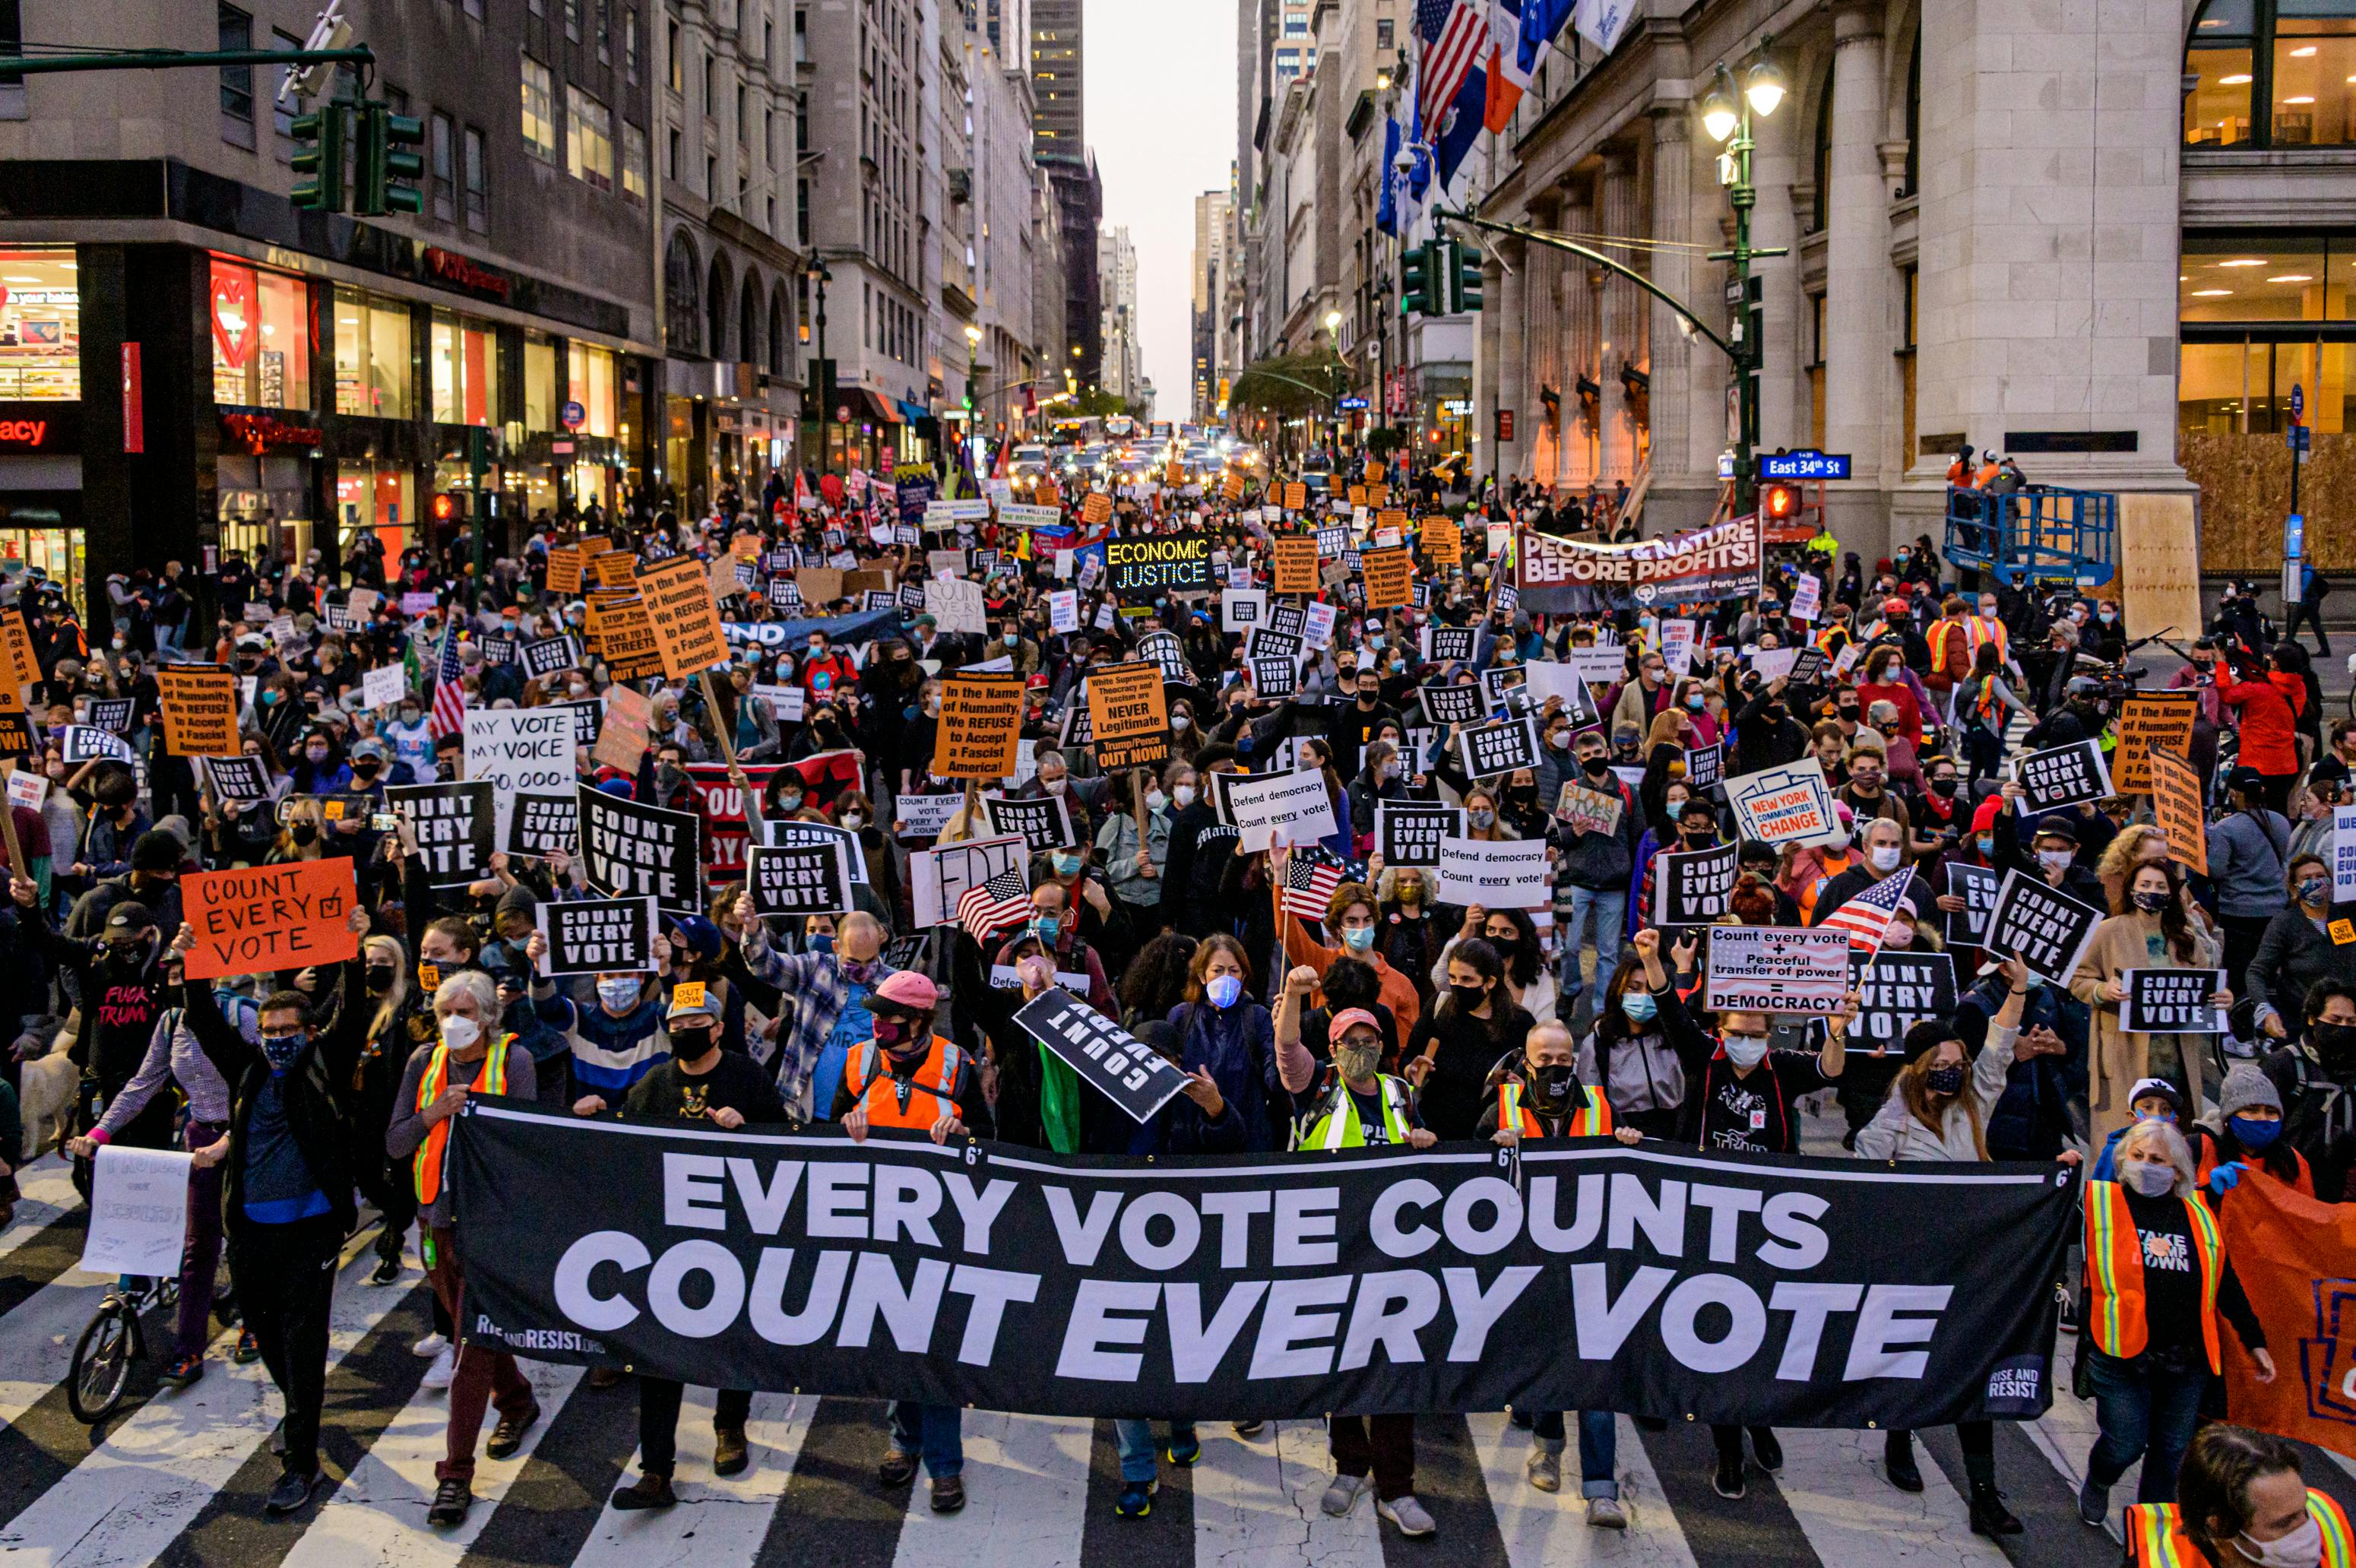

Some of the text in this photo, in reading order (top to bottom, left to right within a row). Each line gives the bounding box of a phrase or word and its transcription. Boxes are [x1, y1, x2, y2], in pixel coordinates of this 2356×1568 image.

[1770, 460, 1840, 474] East 34th St
[1015, 515, 1058, 524] REVOLUTION
[1524, 519, 1755, 561] PEOPLE & NATURE
[1108, 539, 1208, 565] ECONOMIC
[1525, 540, 1756, 583] BEFORE PROFITS!
[1116, 561, 1206, 589] JUSTICE
[1658, 575, 1758, 594] Communist Party USA
[604, 629, 643, 642] TAKE TO
[665, 616, 711, 639] to Accept
[607, 637, 657, 655] STREETS
[672, 631, 714, 654] a Fascist
[1258, 641, 1294, 655] EVERY
[1260, 633, 1296, 646] COUNT
[1436, 639, 1468, 648] EVERY
[677, 647, 719, 670] America!
[1436, 648, 1466, 657] VOTE
[1260, 661, 1289, 670] COUNT
[1116, 673, 1157, 684] Supremacy,
[1261, 670, 1290, 680] EVERY
[946, 686, 1019, 698] In the Name
[1099, 685, 1137, 695] Theocracy
[1262, 680, 1290, 693] VOTE
[1432, 689, 1472, 699] COUNT
[1104, 694, 1136, 703] Fascism
[1433, 698, 1474, 709] EVERY
[943, 702, 1019, 715] of Humanity,
[1108, 702, 1149, 720] NEVER
[1436, 707, 1477, 721] VOTE
[2126, 705, 2191, 717] In the Name
[471, 716, 567, 736] MY VOTE
[946, 716, 1014, 728] We REFUSE
[1100, 716, 1161, 733] Legitimate
[2123, 721, 2190, 733] of Humanity,
[950, 731, 1006, 745] to Accept
[1104, 736, 1161, 752] Trump/Pence
[1475, 727, 1519, 744] COUNT
[2124, 735, 2184, 746] We REFUSE
[179, 741, 227, 752] America!
[471, 739, 565, 760] MY VOICE
[949, 747, 1004, 758] a Fascist
[1477, 736, 1522, 755] EVERY
[1098, 744, 1167, 768] OUT NOW!
[1480, 749, 1525, 768] VOTE
[2024, 750, 2082, 776] COUNT
[948, 761, 1002, 772] America!
[2027, 762, 2085, 789] EVERY
[935, 796, 961, 804] EVERY
[1233, 781, 1323, 808] Defend democracy
[1564, 784, 1615, 814] BLACK
[1752, 790, 1810, 814] NEW YORK
[996, 806, 1047, 818] COUNT
[1239, 801, 1330, 829] Count every vote!
[1757, 804, 1810, 822] COMMUNITIES
[592, 803, 676, 842] COUNT
[999, 817, 1048, 831] EVERY
[1394, 816, 1450, 828] COUNT
[1759, 812, 1820, 838] CHANGE
[1394, 828, 1449, 844] EVERY
[592, 828, 675, 868] EVERY
[1441, 848, 1544, 864] Defend democracy
[759, 854, 822, 870] COUNT
[1683, 854, 1734, 876] COUNT
[593, 856, 676, 898] VOTE
[759, 869, 824, 887] EVERY
[1441, 868, 1544, 885] Count every vote!
[202, 870, 303, 906] COUNT
[761, 886, 830, 907] VOTE
[207, 894, 311, 936] EVERY
[562, 908, 633, 925] COUNT
[2016, 889, 2082, 927] COUNT
[562, 923, 632, 942] EVERY
[2007, 903, 2073, 946] EVERY
[2333, 926, 2348, 934] OUT
[1712, 930, 1847, 946] Count every vote
[2335, 930, 2353, 941] NOW
[213, 927, 312, 966] VOTE
[563, 942, 635, 965] VOTE
[2000, 924, 2063, 968] VOTE
[1746, 955, 1810, 966] Peaceful
[1715, 965, 1841, 978] transfer of power
[2142, 976, 2206, 988] COUNT
[105, 985, 149, 1003] FUCK
[676, 996, 702, 1006] NOW
[677, 987, 701, 999] OUT
[2142, 987, 2206, 1005] EVERY
[1713, 994, 1840, 1011] DEMOCRACY
[99, 1006, 147, 1028] TRUM
[2142, 1005, 2204, 1024] VOTE
[662, 1151, 1830, 1272] EVERY VOTE COUNTS
[553, 1229, 1955, 1383] COUNT EVERY VOTE
[1990, 1368, 2038, 1384] RISE AND
[1989, 1381, 2038, 1400] RESIST
